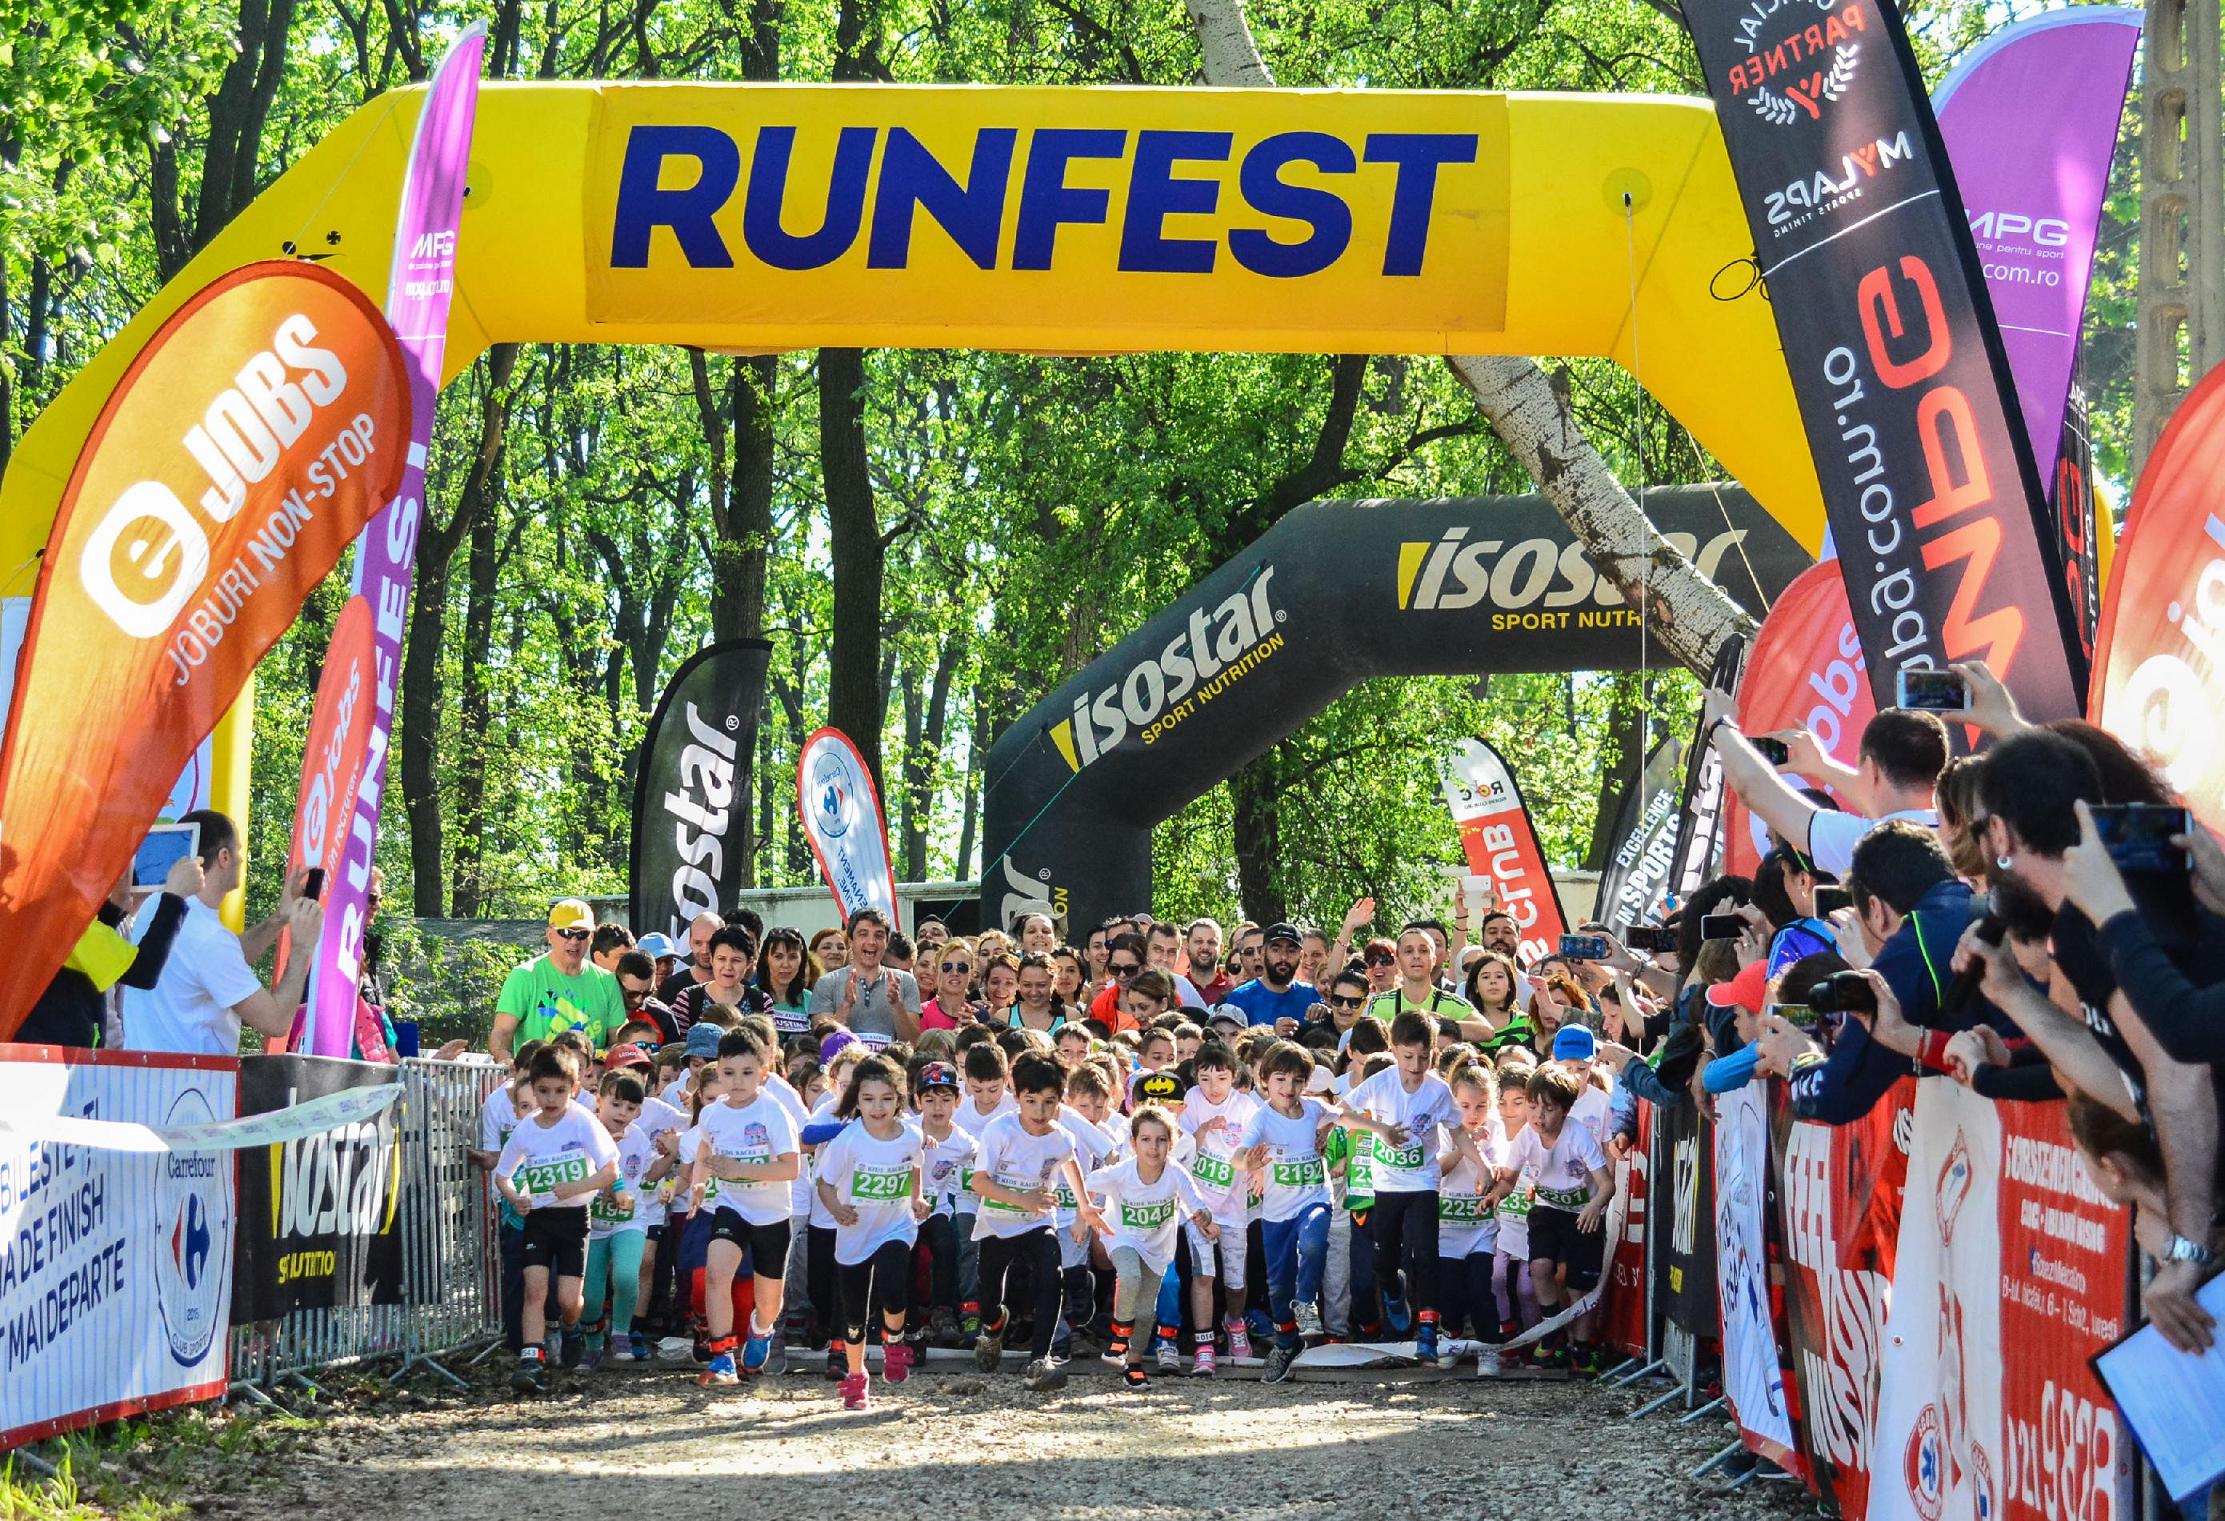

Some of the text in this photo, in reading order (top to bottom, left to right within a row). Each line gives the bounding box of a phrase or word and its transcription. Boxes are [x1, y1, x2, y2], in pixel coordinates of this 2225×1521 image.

[610, 125, 1479, 278] RUNFEST
[1983, 263, 2060, 287] com.ro
[1996, 244, 2032, 256] pentru
[2036, 249, 2064, 259] sport
[183, 313, 348, 524] JOBS
[165, 412, 376, 688] JOBURI NON-STOP
[1413, 527, 1749, 611] isosr
[1491, 609, 1644, 631] SPORT NUTR
[1073, 565, 1276, 768] isostar
[1141, 631, 1286, 745] SPORT NUTRITION
[337, 440, 429, 984] RUNFES
[664, 700, 738, 958] sostar
[1615, 787, 1676, 869] EXCELLENCE
[1614, 899, 1637, 927] IN
[167, 1150, 216, 1179] Carrefour
[529, 1160, 585, 1189] 2319
[856, 1173, 909, 1196] 2297
[1278, 1161, 1324, 1182] 2192
[1375, 1141, 1422, 1165] 2036
[20, 1216, 45, 1283] DE
[48, 1172, 104, 1263] FINISH
[1125, 1200, 1172, 1226] 2046
[1442, 1199, 1490, 1217] 225
[8, 1297, 44, 1373] MAI
[46, 1236, 127, 1345] DEPARTE
[2040, 1379, 2117, 1521] 9828
